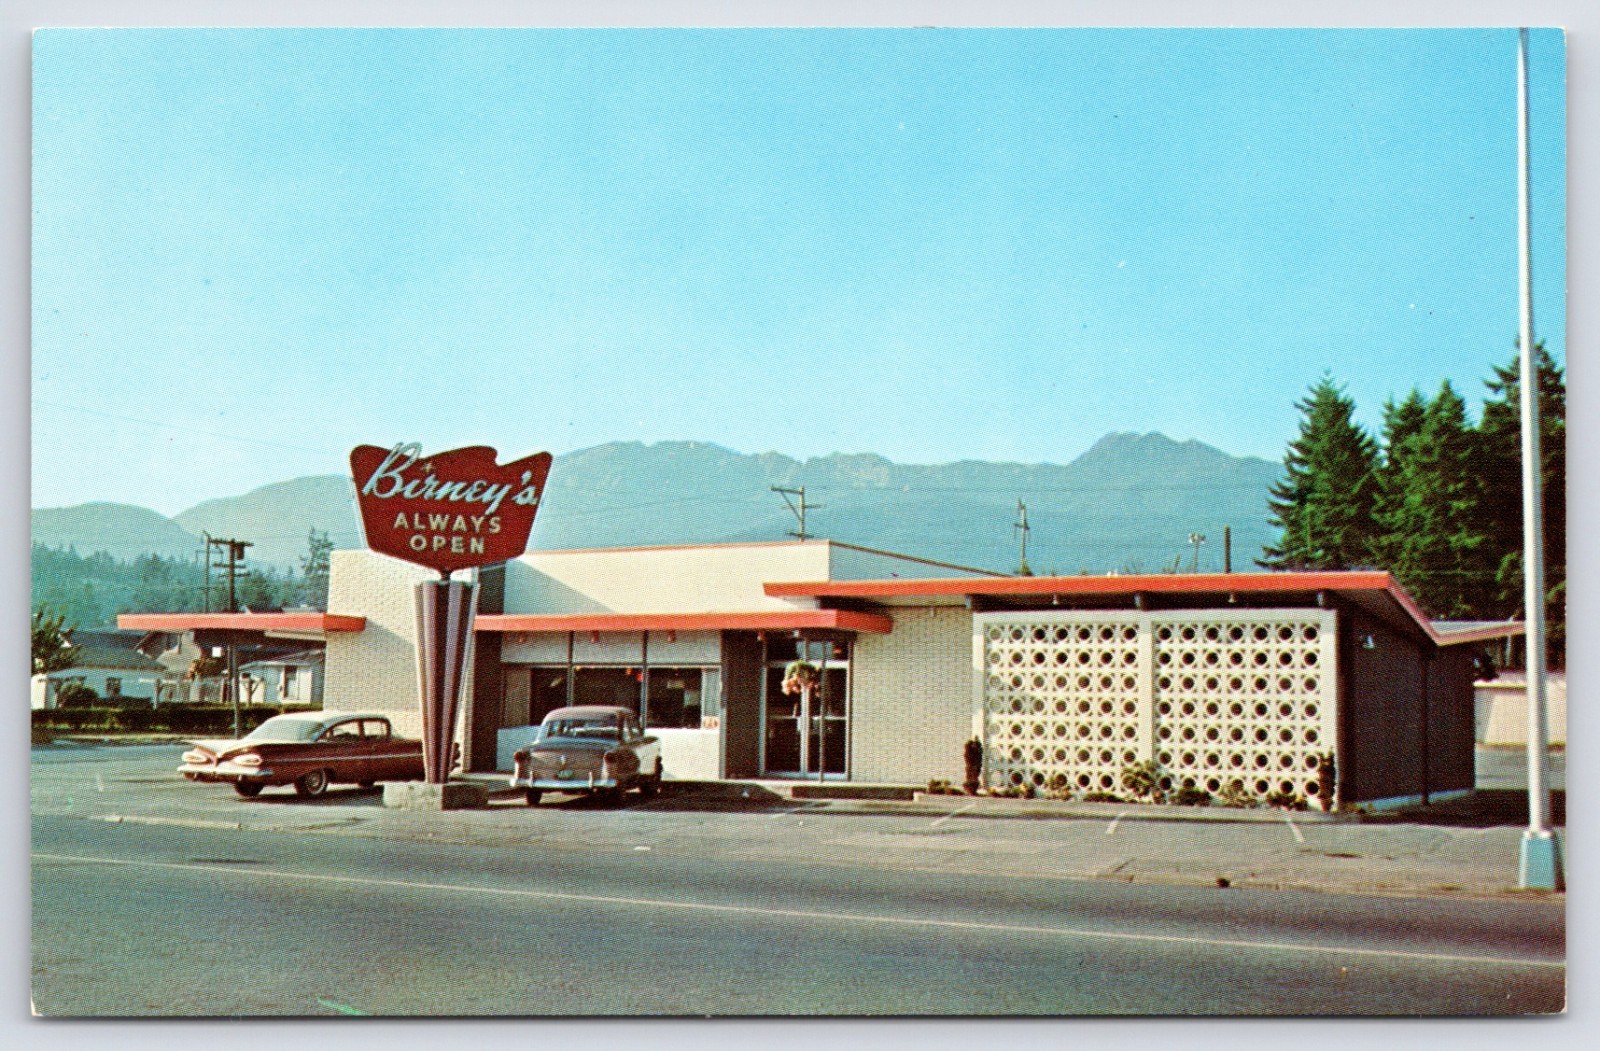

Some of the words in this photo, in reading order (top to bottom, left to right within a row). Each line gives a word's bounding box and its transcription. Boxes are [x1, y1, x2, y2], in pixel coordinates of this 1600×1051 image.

[362, 442, 538, 515] Birney's
[393, 512, 502, 534] ALWAYS
[409, 535, 485, 554] OPEN
